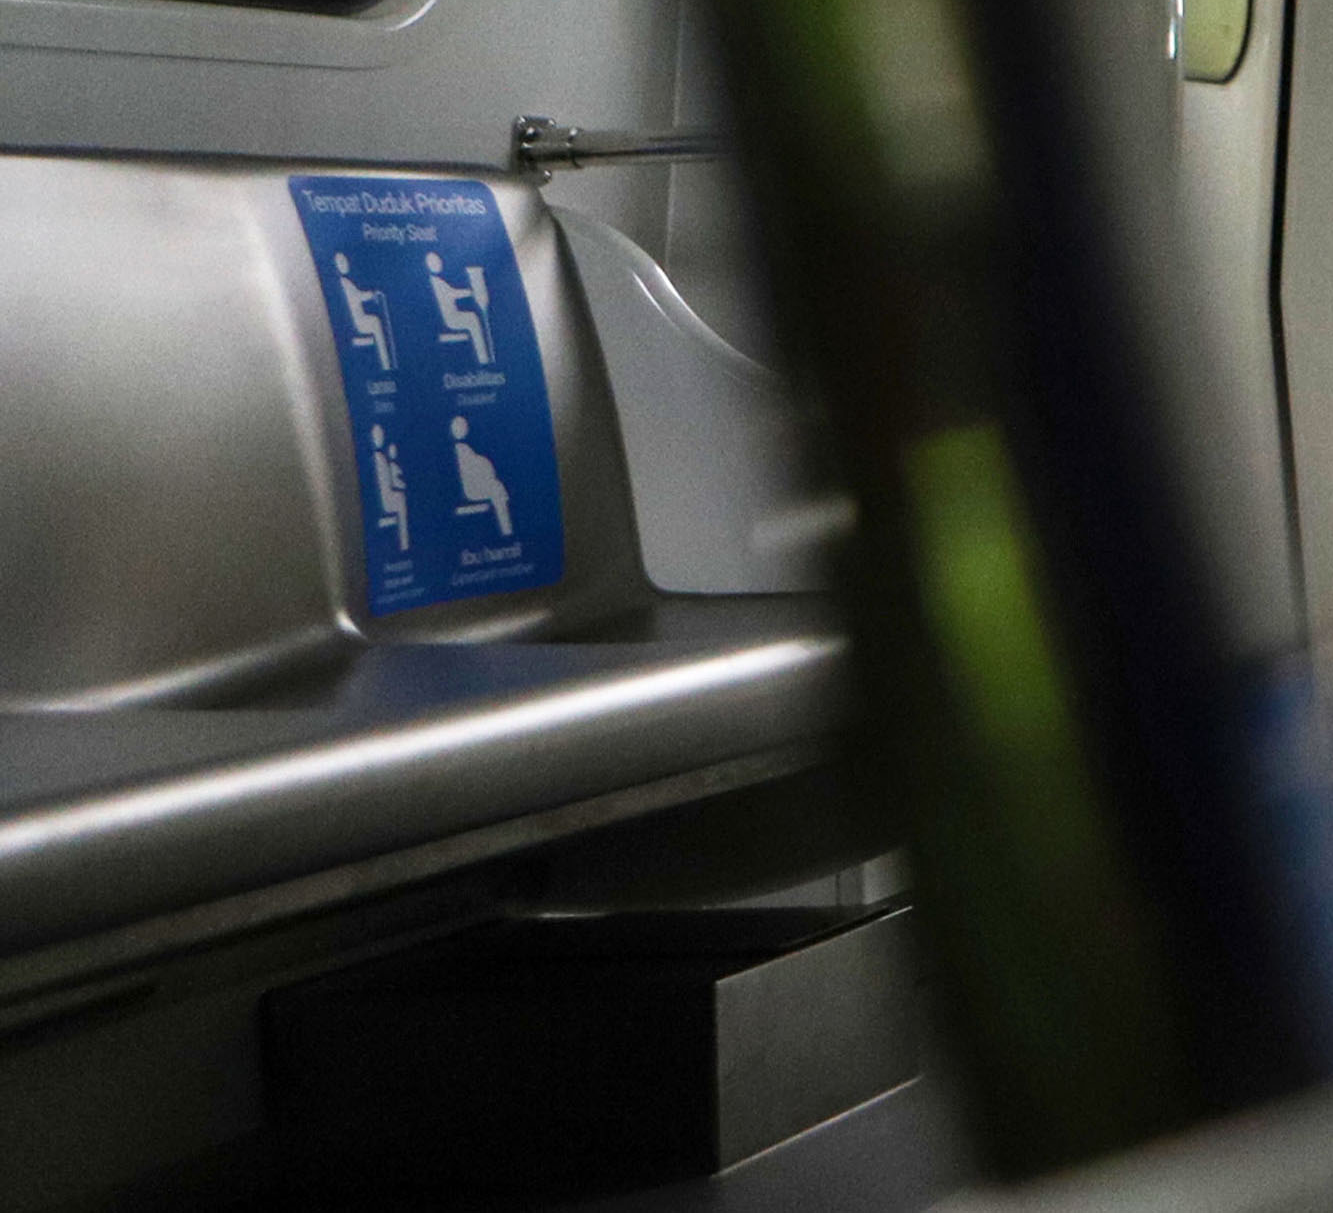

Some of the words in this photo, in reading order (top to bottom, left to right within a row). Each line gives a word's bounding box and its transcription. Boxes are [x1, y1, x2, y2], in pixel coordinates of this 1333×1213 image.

[302, 190, 361, 217] Tempat
[361, 191, 414, 214] Duduk
[415, 193, 487, 215] Prioritas
